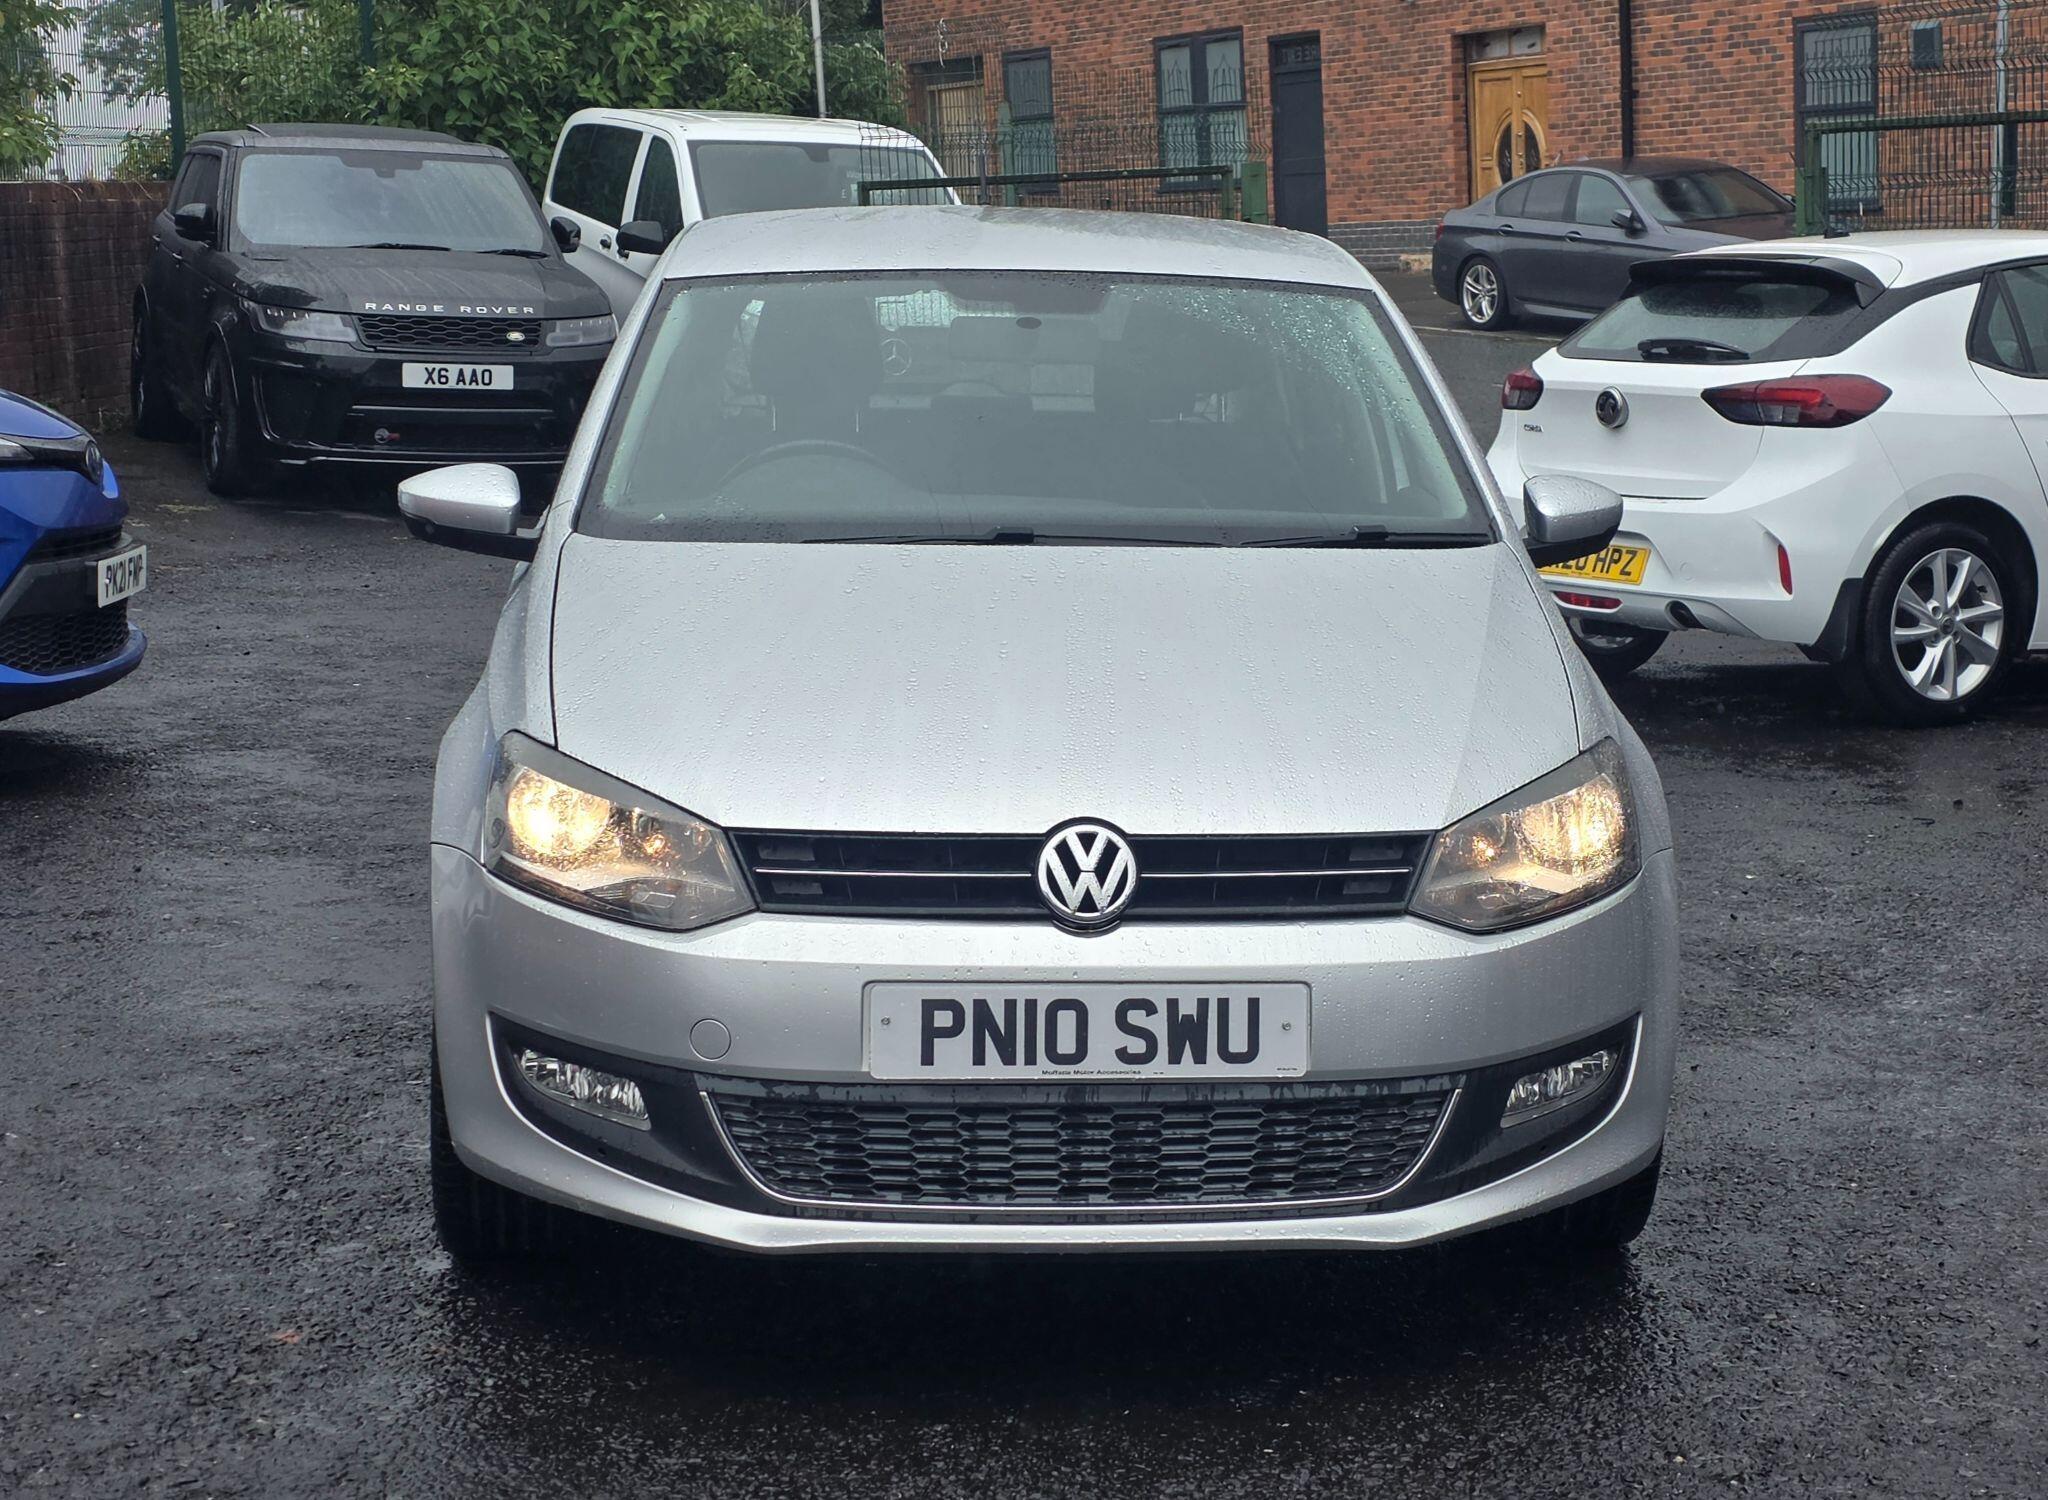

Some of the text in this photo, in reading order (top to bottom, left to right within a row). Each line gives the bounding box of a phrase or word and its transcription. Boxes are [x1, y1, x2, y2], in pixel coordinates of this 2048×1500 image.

[365, 302, 534, 315] RANGE ROVER
[424, 367, 493, 386] X6 AAO
[105, 560, 127, 598] PK21
[1592, 547, 1638, 577] HPZ
[1038, 825, 1137, 918] VW
[920, 997, 1260, 1067] PN10 SWU
